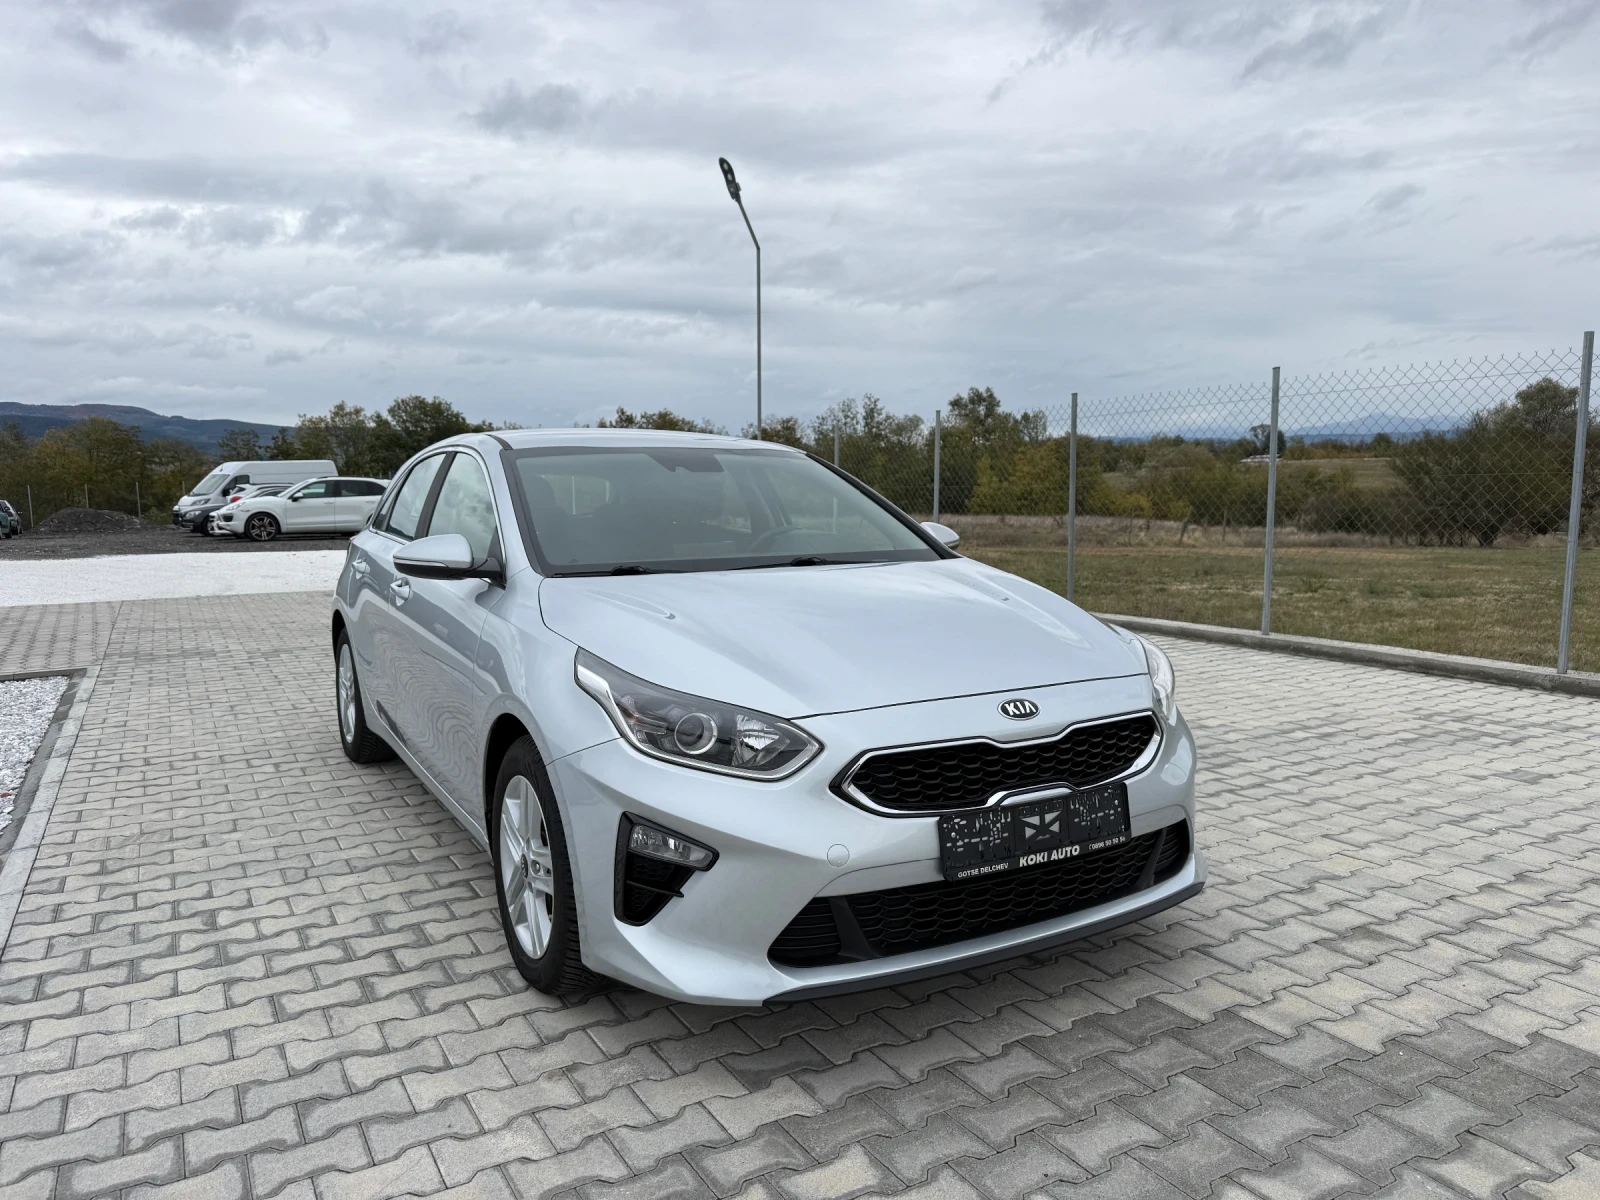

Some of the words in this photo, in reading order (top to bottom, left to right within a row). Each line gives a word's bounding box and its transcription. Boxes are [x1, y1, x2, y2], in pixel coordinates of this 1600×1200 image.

[1004, 701, 1037, 716] KIA
[1019, 851, 1048, 868] KOKI
[1050, 845, 1080, 861] AUTO
[957, 868, 979, 878] GOTSE
[980, 862, 1009, 874] DELCHEV
